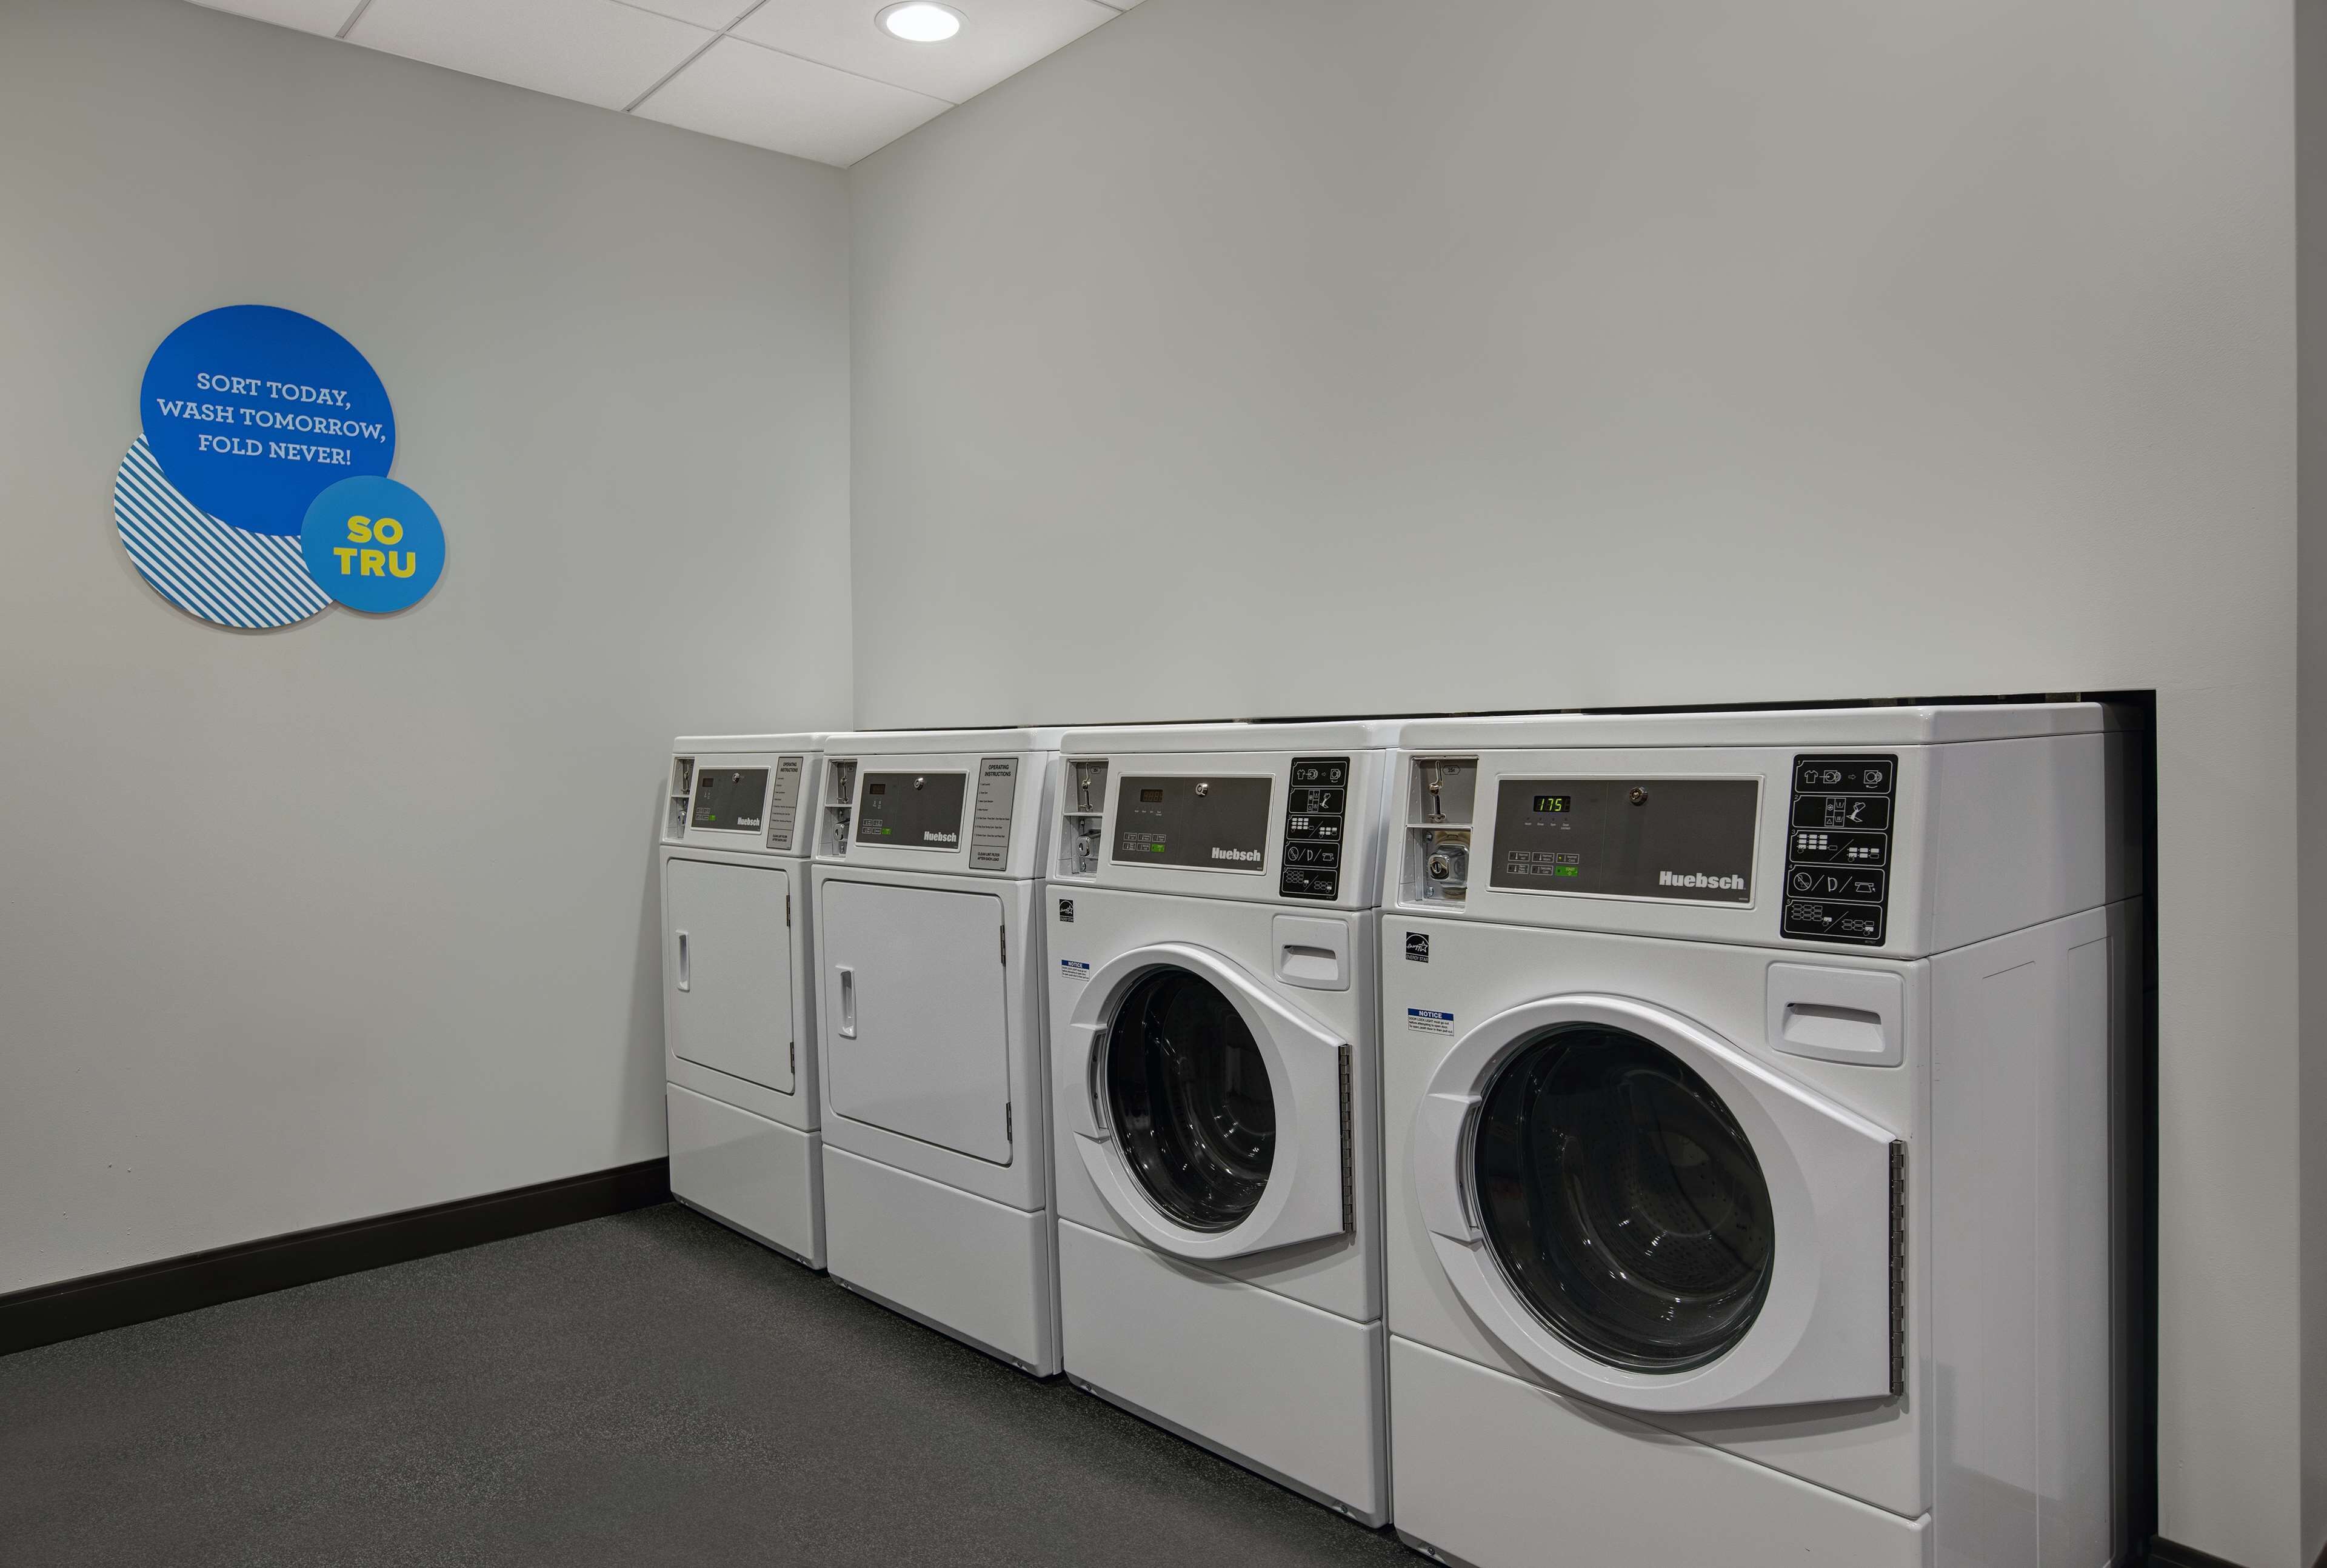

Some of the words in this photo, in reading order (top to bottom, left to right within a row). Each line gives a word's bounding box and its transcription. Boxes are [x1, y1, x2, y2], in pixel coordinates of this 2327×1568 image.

[197, 373, 261, 396] SORT
[267, 381, 351, 410] TODAY,
[157, 398, 234, 424] WASH
[240, 409, 386, 443] TOMORROW,
[199, 434, 262, 456] FOLD
[269, 442, 351, 465] NEVER!
[347, 516, 403, 545] SO
[333, 547, 416, 578] TRU
[1540, 798, 1562, 811] 175
[737, 817, 760, 826] Huebsch
[924, 831, 957, 842] Huebsch
[1212, 847, 1261, 861] Huebsch
[1659, 871, 1744, 890] Huebsch
